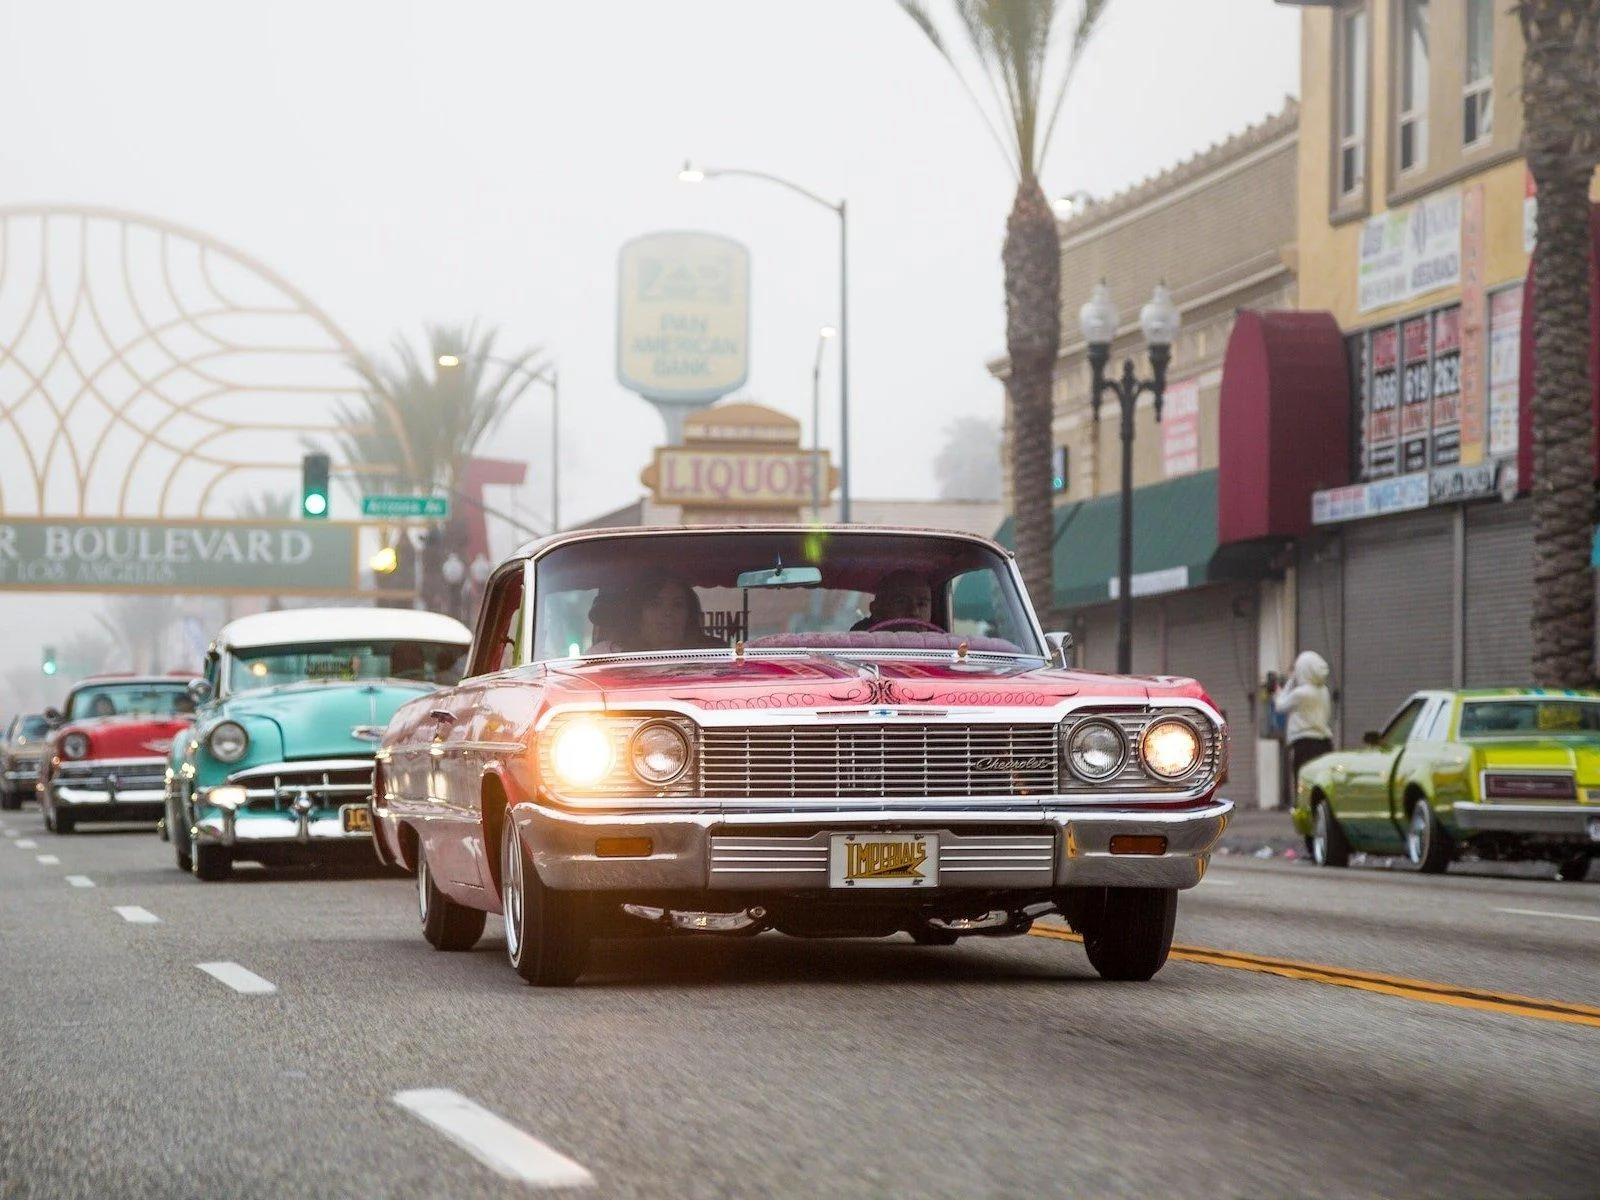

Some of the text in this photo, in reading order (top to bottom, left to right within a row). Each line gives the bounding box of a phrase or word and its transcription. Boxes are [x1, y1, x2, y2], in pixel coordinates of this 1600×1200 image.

[660, 312, 708, 333] PAN
[631, 335, 738, 356] AMERICAN
[653, 357, 710, 378] BANK
[666, 456, 823, 500] LIQUOR
[45, 525, 313, 564] BOULEVARD
[18, 559, 65, 582] LOS
[76, 561, 177, 584] ANGELES
[976, 757, 1049, 771] Chevrolet
[843, 842, 928, 879] IMPERIALS
